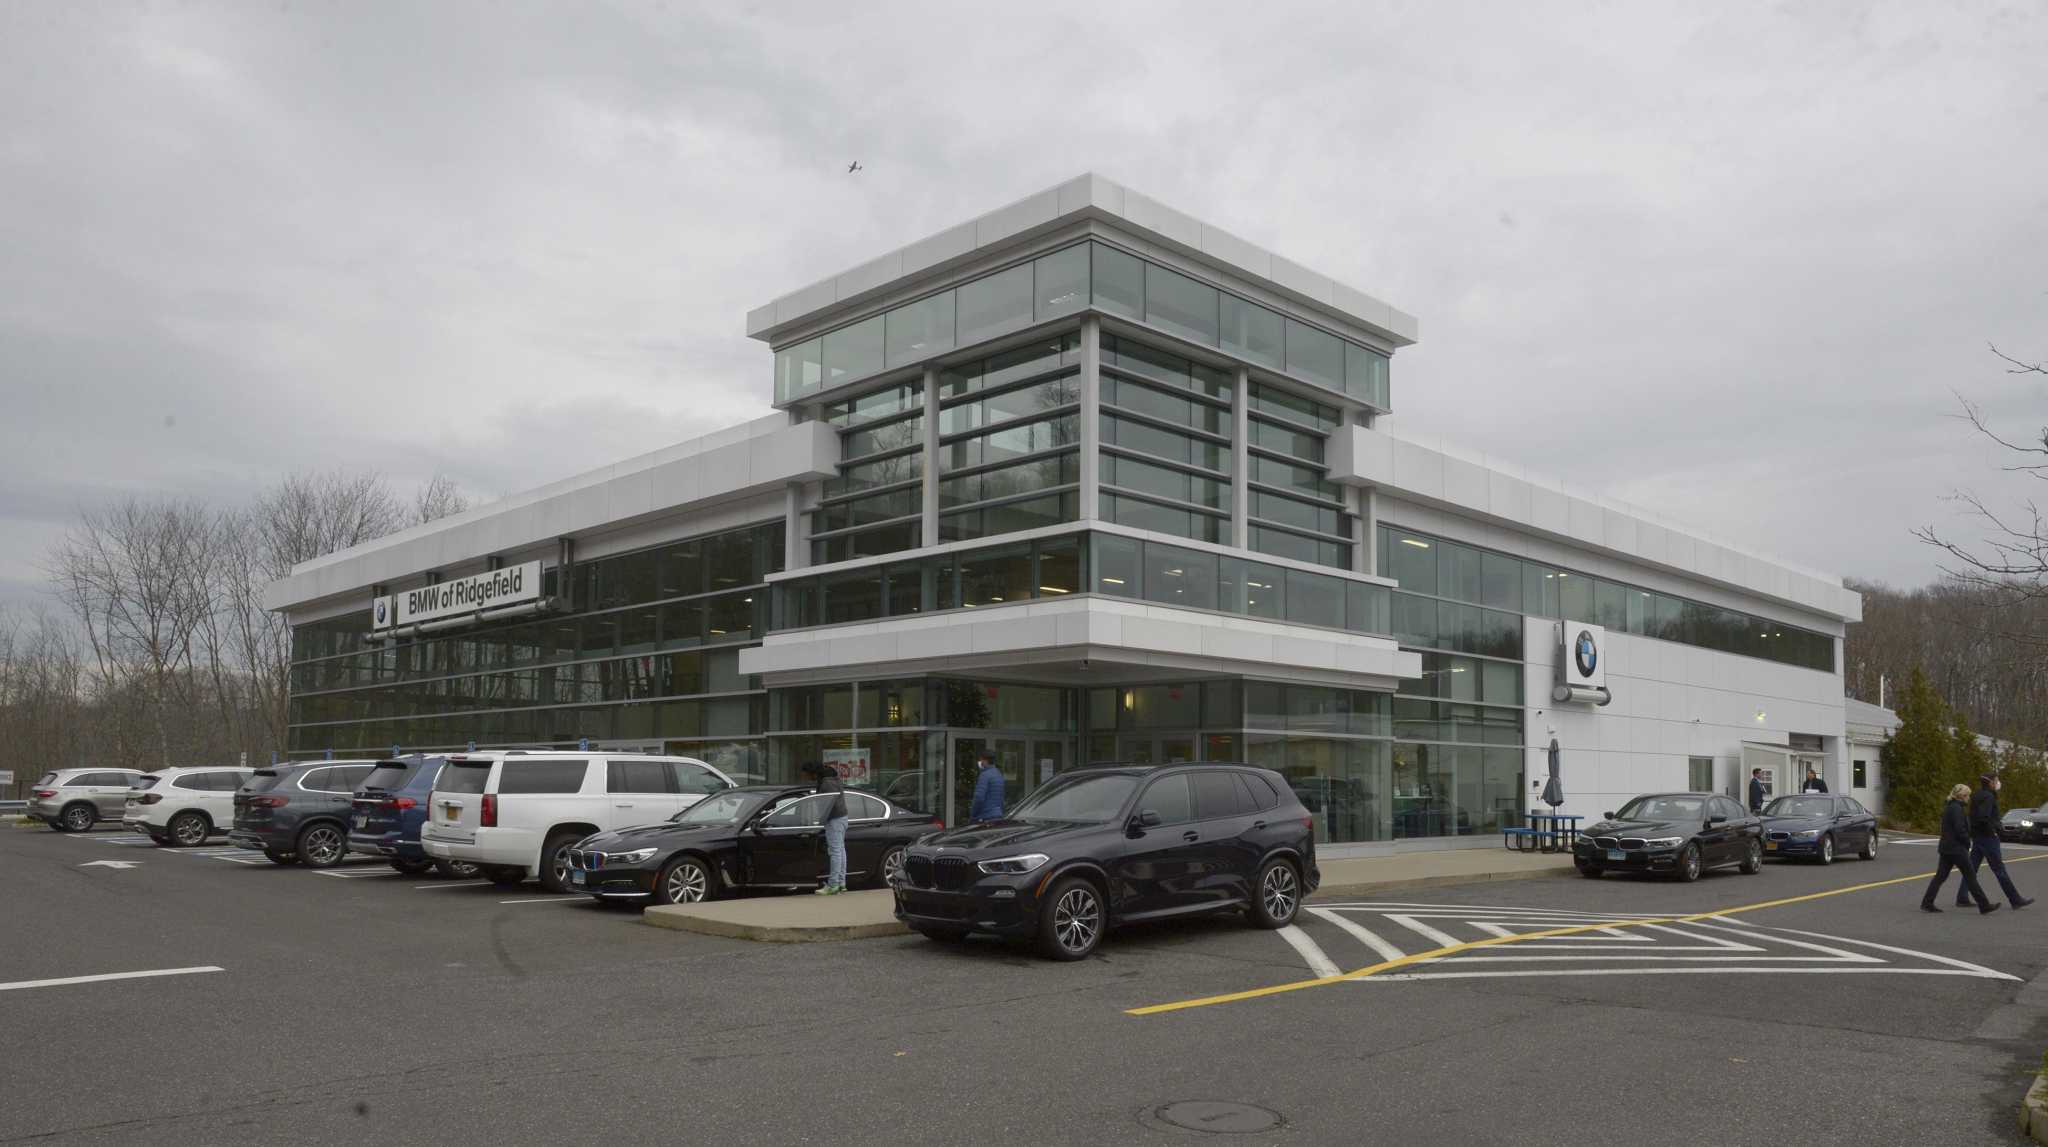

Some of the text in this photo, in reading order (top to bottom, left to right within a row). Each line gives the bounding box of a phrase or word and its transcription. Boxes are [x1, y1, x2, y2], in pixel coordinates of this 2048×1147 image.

[409, 567, 522, 615] BMW of Ridgefield
